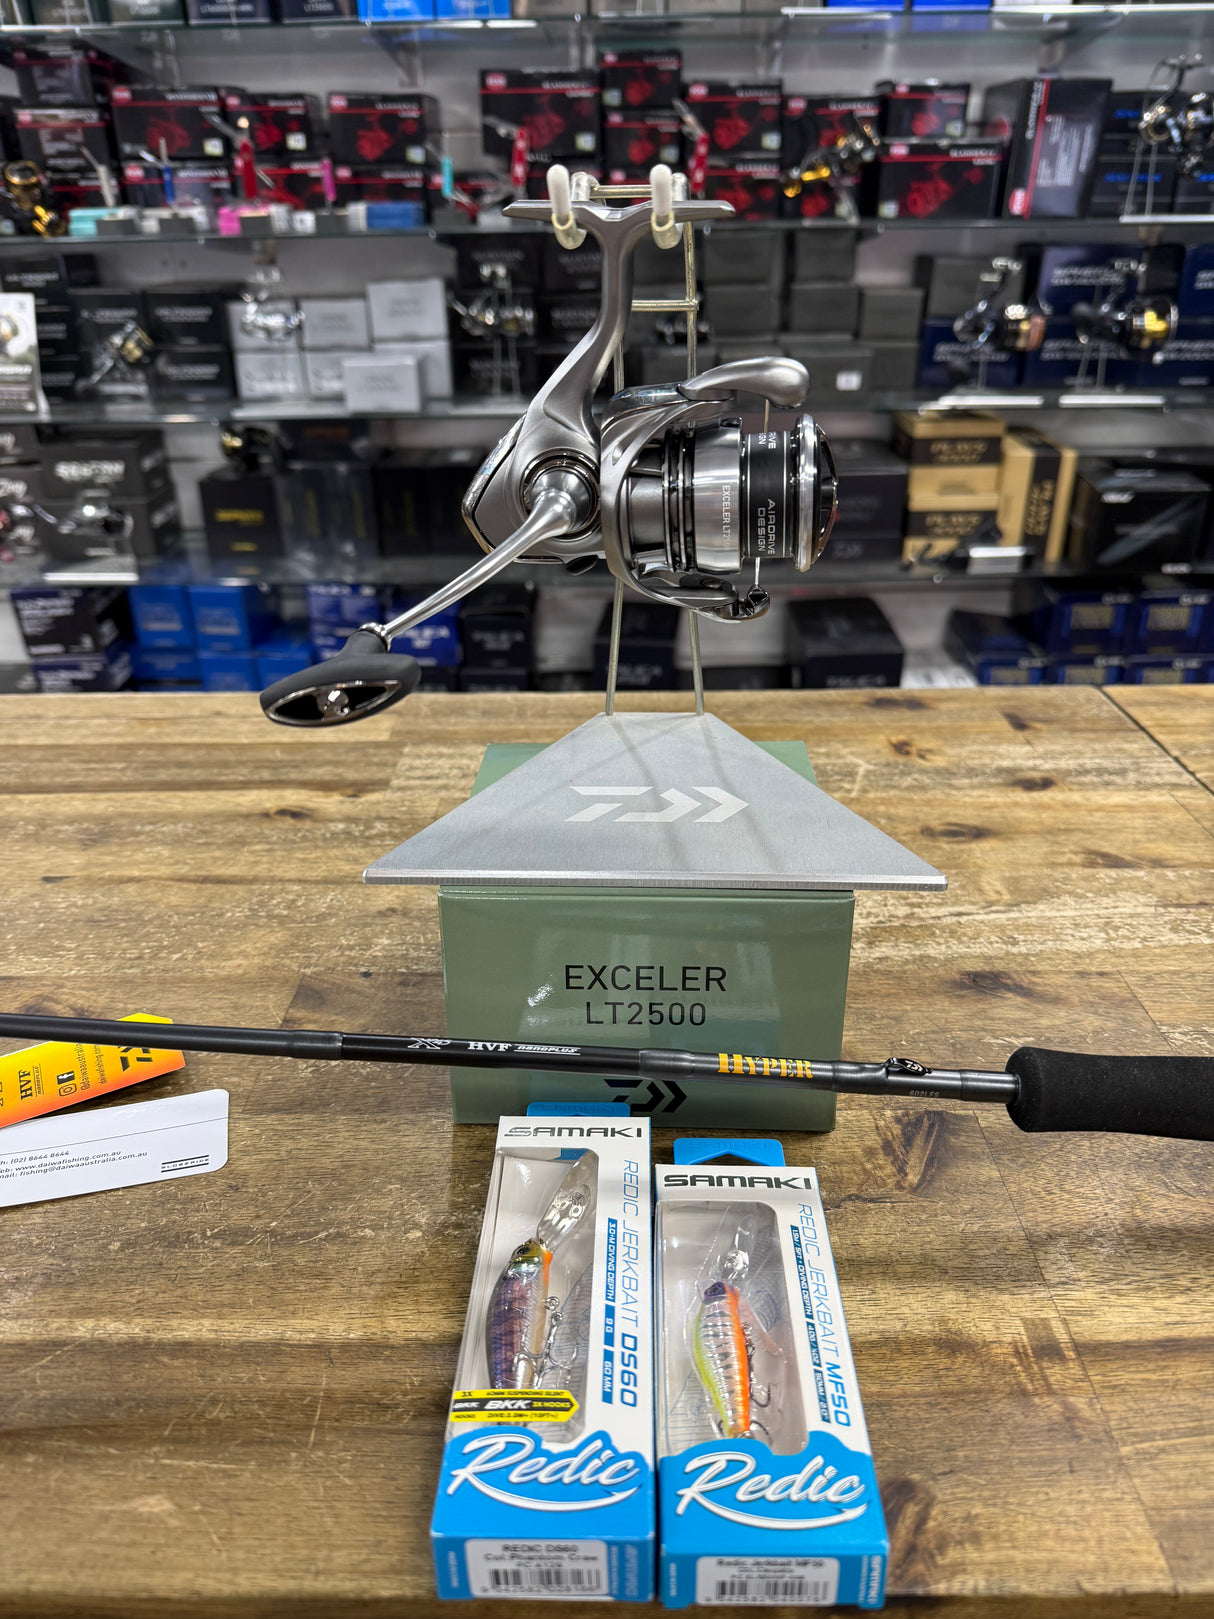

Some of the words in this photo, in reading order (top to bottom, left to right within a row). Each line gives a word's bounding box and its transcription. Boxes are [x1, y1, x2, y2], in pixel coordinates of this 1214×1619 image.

[722, 484, 731, 524] EXCELER
[757, 507, 766, 552] DESIGN
[767, 498, 776, 555] AIRDRIVE
[564, 964, 727, 992] EXCELER
[586, 1001, 706, 1026] LT2500
[467, 1041, 512, 1052] HVF
[717, 1053, 813, 1079] HYPER
[18, 1069, 33, 1100] HVF
[504, 1126, 642, 1138] SAMAKI
[10, 1157, 27, 1165] (02)
[28, 1154, 48, 1162] 8644
[15, 1151, 122, 1172] www.daiwafishing.com.au
[20, 1152, 148, 1177] fishing@daiwaaustralia.com.au
[623, 1159, 638, 1217] REDIC
[664, 1174, 812, 1190] SAMAKI
[798, 1203, 820, 1257] REDIC
[607, 1244, 615, 1272] DIVING
[606, 1271, 614, 1300] DEPTH
[621, 1219, 638, 1328] JERKBAIT
[808, 1258, 839, 1358] JERKBAIT
[620, 1332, 638, 1408] DS60
[484, 1400, 532, 1410] BKK
[825, 1361, 851, 1427] MF50
[447, 1433, 642, 1511] Redic
[676, 1451, 868, 1530] Redic
